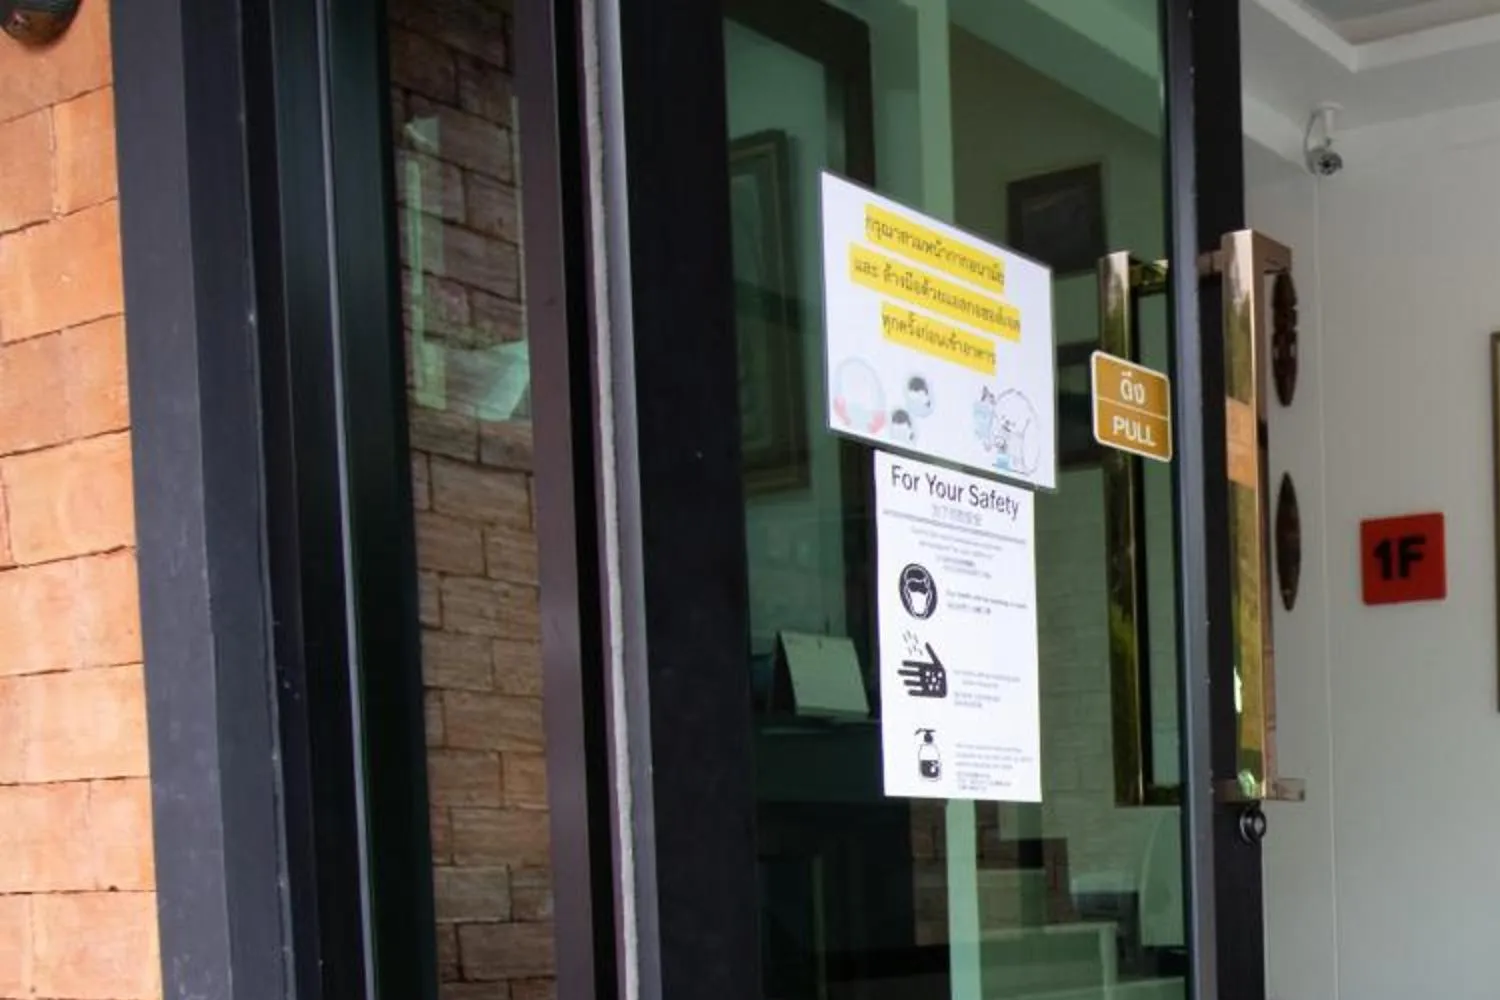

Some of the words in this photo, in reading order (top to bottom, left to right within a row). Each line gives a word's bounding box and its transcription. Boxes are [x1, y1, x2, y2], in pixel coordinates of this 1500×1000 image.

[1119, 371, 1146, 405] ดึง
[1112, 415, 1157, 447] PULL
[891, 465, 920, 491] For
[925, 473, 964, 503] Your
[968, 484, 1020, 521] Safety
[1373, 533, 1426, 581] 1F
